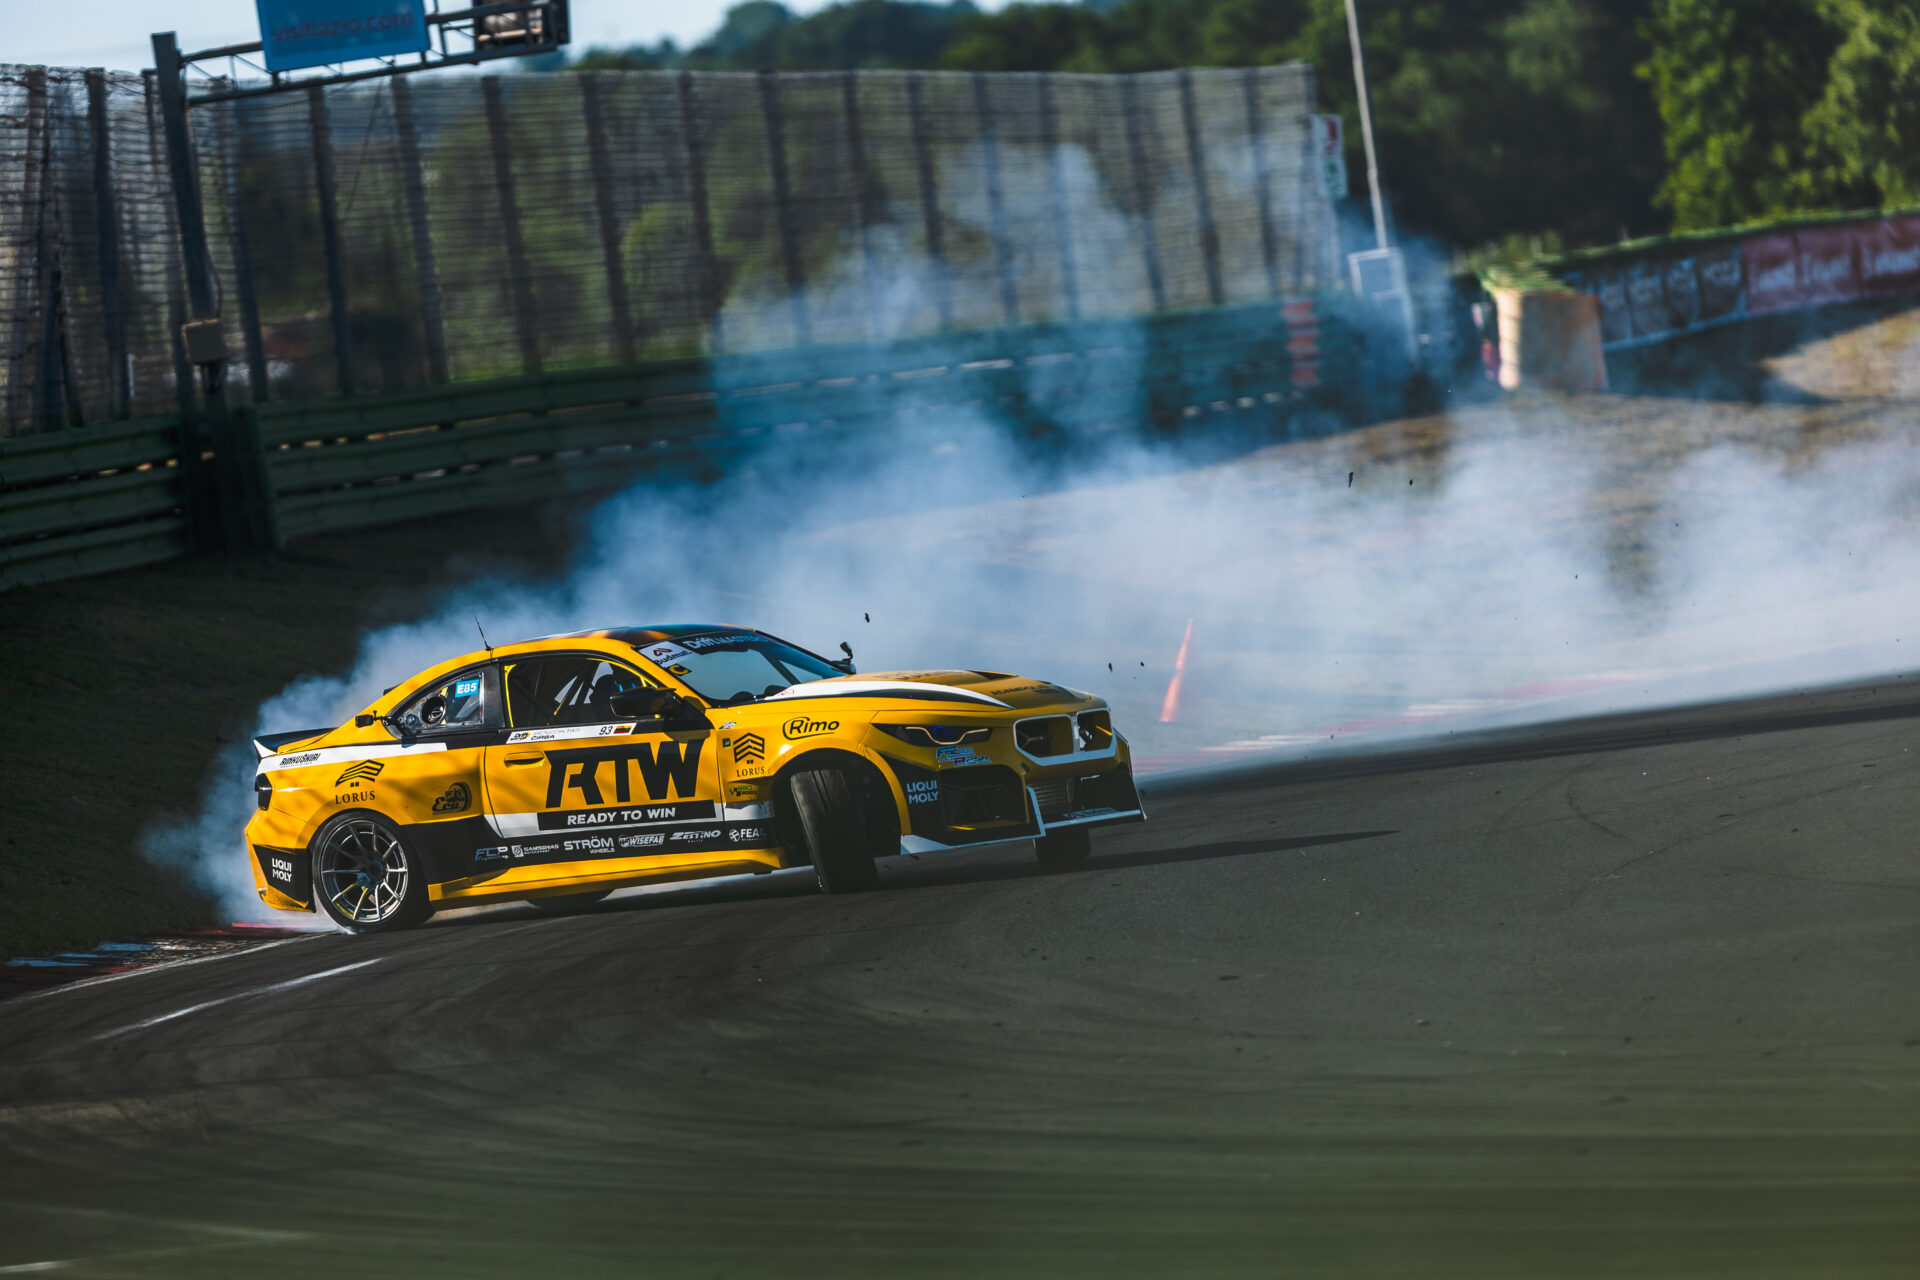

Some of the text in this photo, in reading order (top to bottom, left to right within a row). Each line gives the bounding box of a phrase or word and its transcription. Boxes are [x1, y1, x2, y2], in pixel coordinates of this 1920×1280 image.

[273, 12, 415, 42] visitlazio.com
[457, 682, 477, 694] E85
[599, 726, 613, 735] 93
[789, 720, 840, 735] Rimo
[544, 738, 706, 808] RTW
[736, 766, 765, 777] LORUS
[906, 779, 938, 793] LIQUI
[335, 790, 376, 804] LORUS
[908, 791, 939, 804] MOLY
[567, 807, 676, 825] READY TO WIN
[629, 833, 665, 846] WISEFAB
[669, 829, 721, 840] ZESTINO
[523, 844, 559, 852] SAMSONAS
[563, 836, 614, 851] STRÖM
[271, 857, 292, 872] LIQUI
[272, 868, 293, 882] MOLY
